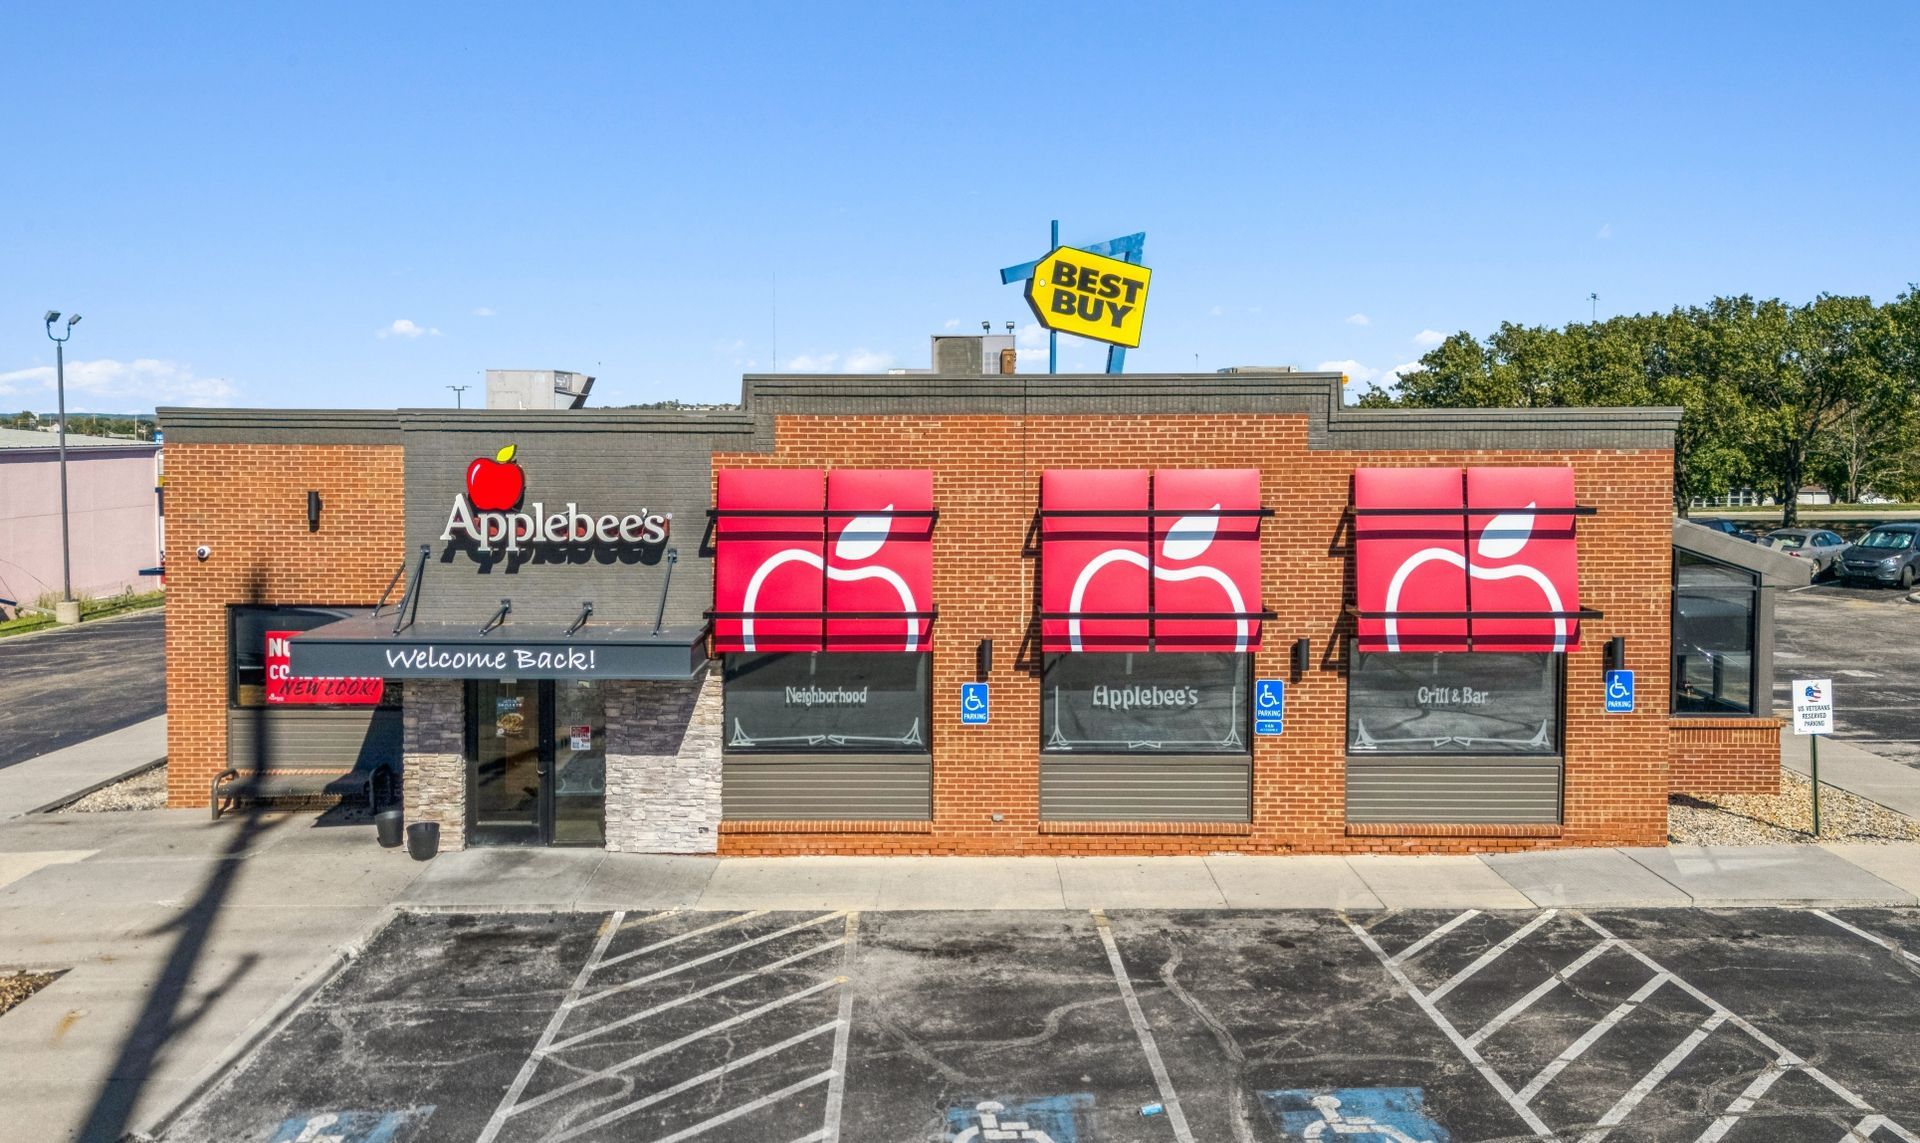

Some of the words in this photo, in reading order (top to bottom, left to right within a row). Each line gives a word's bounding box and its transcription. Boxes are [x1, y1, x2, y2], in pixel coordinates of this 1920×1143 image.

[1051, 259, 1145, 305] BEST
[1051, 287, 1134, 329] BUY
[440, 493, 667, 552] Applebee's
[386, 646, 507, 670] Welcome
[513, 647, 596, 671] Back!
[279, 680, 322, 696] NEW
[325, 680, 379, 696] LOOK!
[785, 685, 868, 707] Neighborhood
[1092, 685, 1199, 711] Applebee's
[1417, 686, 1450, 704] Grill
[1451, 688, 1461, 703] &
[1462, 686, 1489, 704] Bar
[1257, 709, 1281, 717] PARKING
[1607, 700, 1632, 708] PARKING
